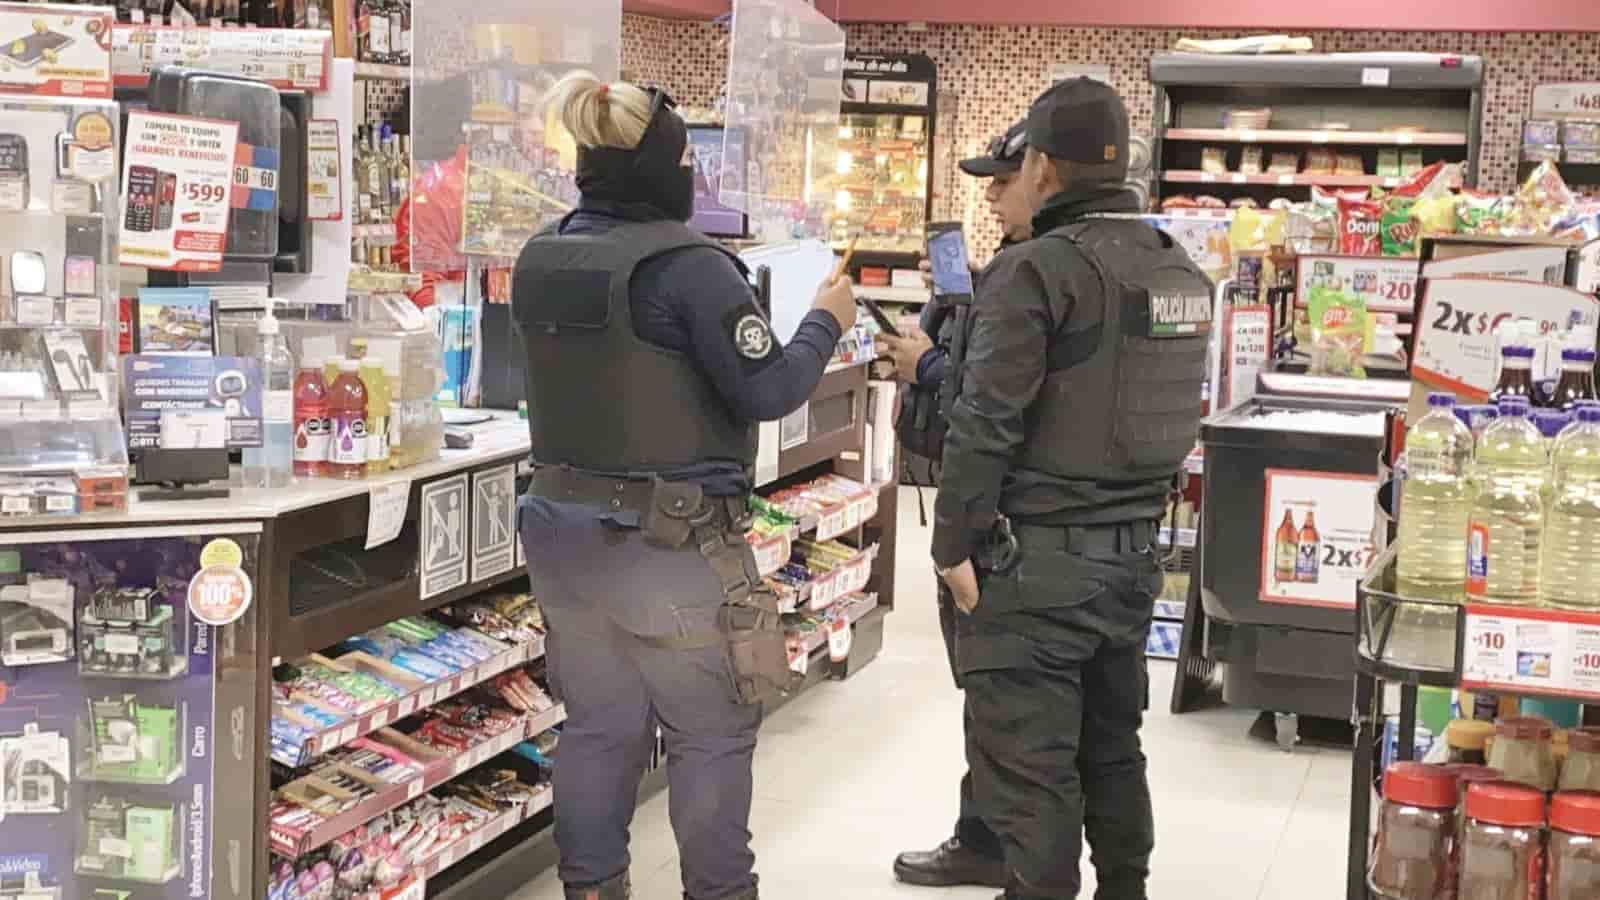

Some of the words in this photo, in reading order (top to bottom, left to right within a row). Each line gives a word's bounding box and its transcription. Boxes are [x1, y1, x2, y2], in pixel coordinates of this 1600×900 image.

[182, 183, 224, 202] $599
[1380, 281, 1412, 300] $20
[191, 726, 206, 757] Carro
